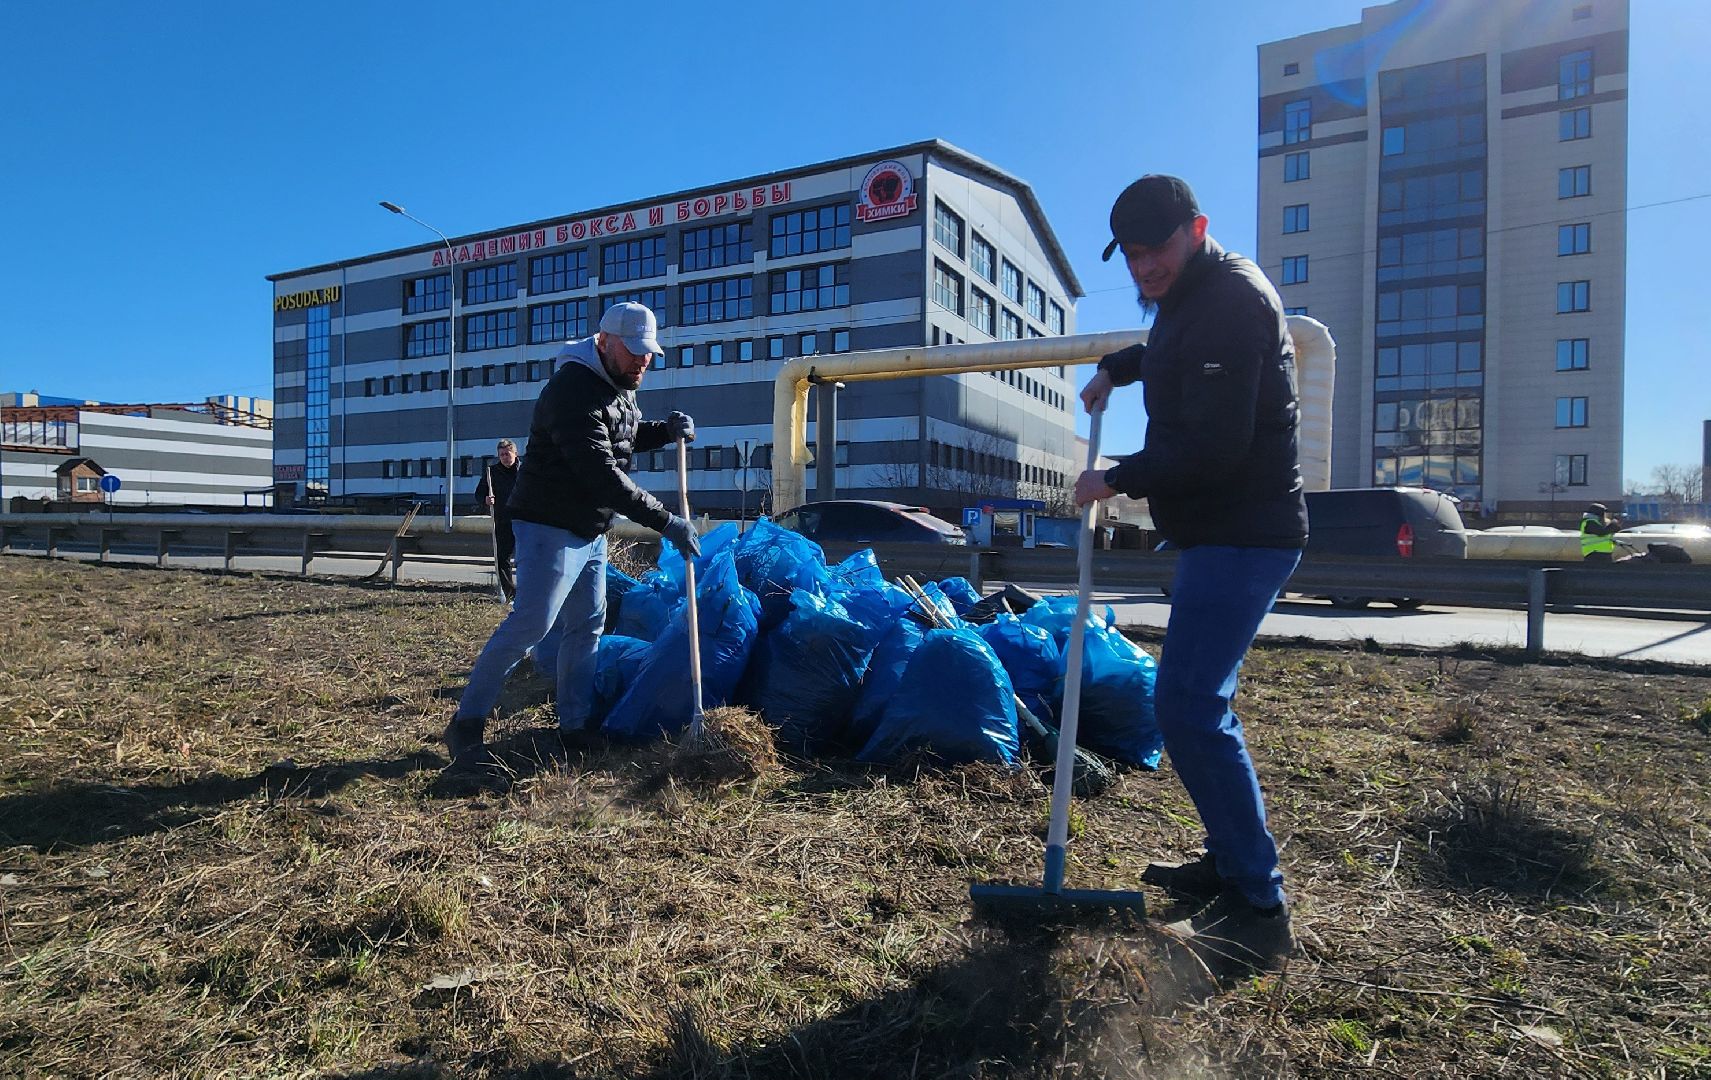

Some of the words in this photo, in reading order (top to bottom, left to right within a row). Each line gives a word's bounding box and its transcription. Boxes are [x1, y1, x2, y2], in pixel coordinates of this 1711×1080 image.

[432, 229, 545, 267] АКАДЕМИЯ
[556, 212, 636, 244] БОКСА
[648, 206, 663, 226] И
[676, 181, 791, 221] БОРЬБЫ
[867, 203, 906, 219] ХИМКИ
[274, 286, 340, 312] POSUDA.RU
